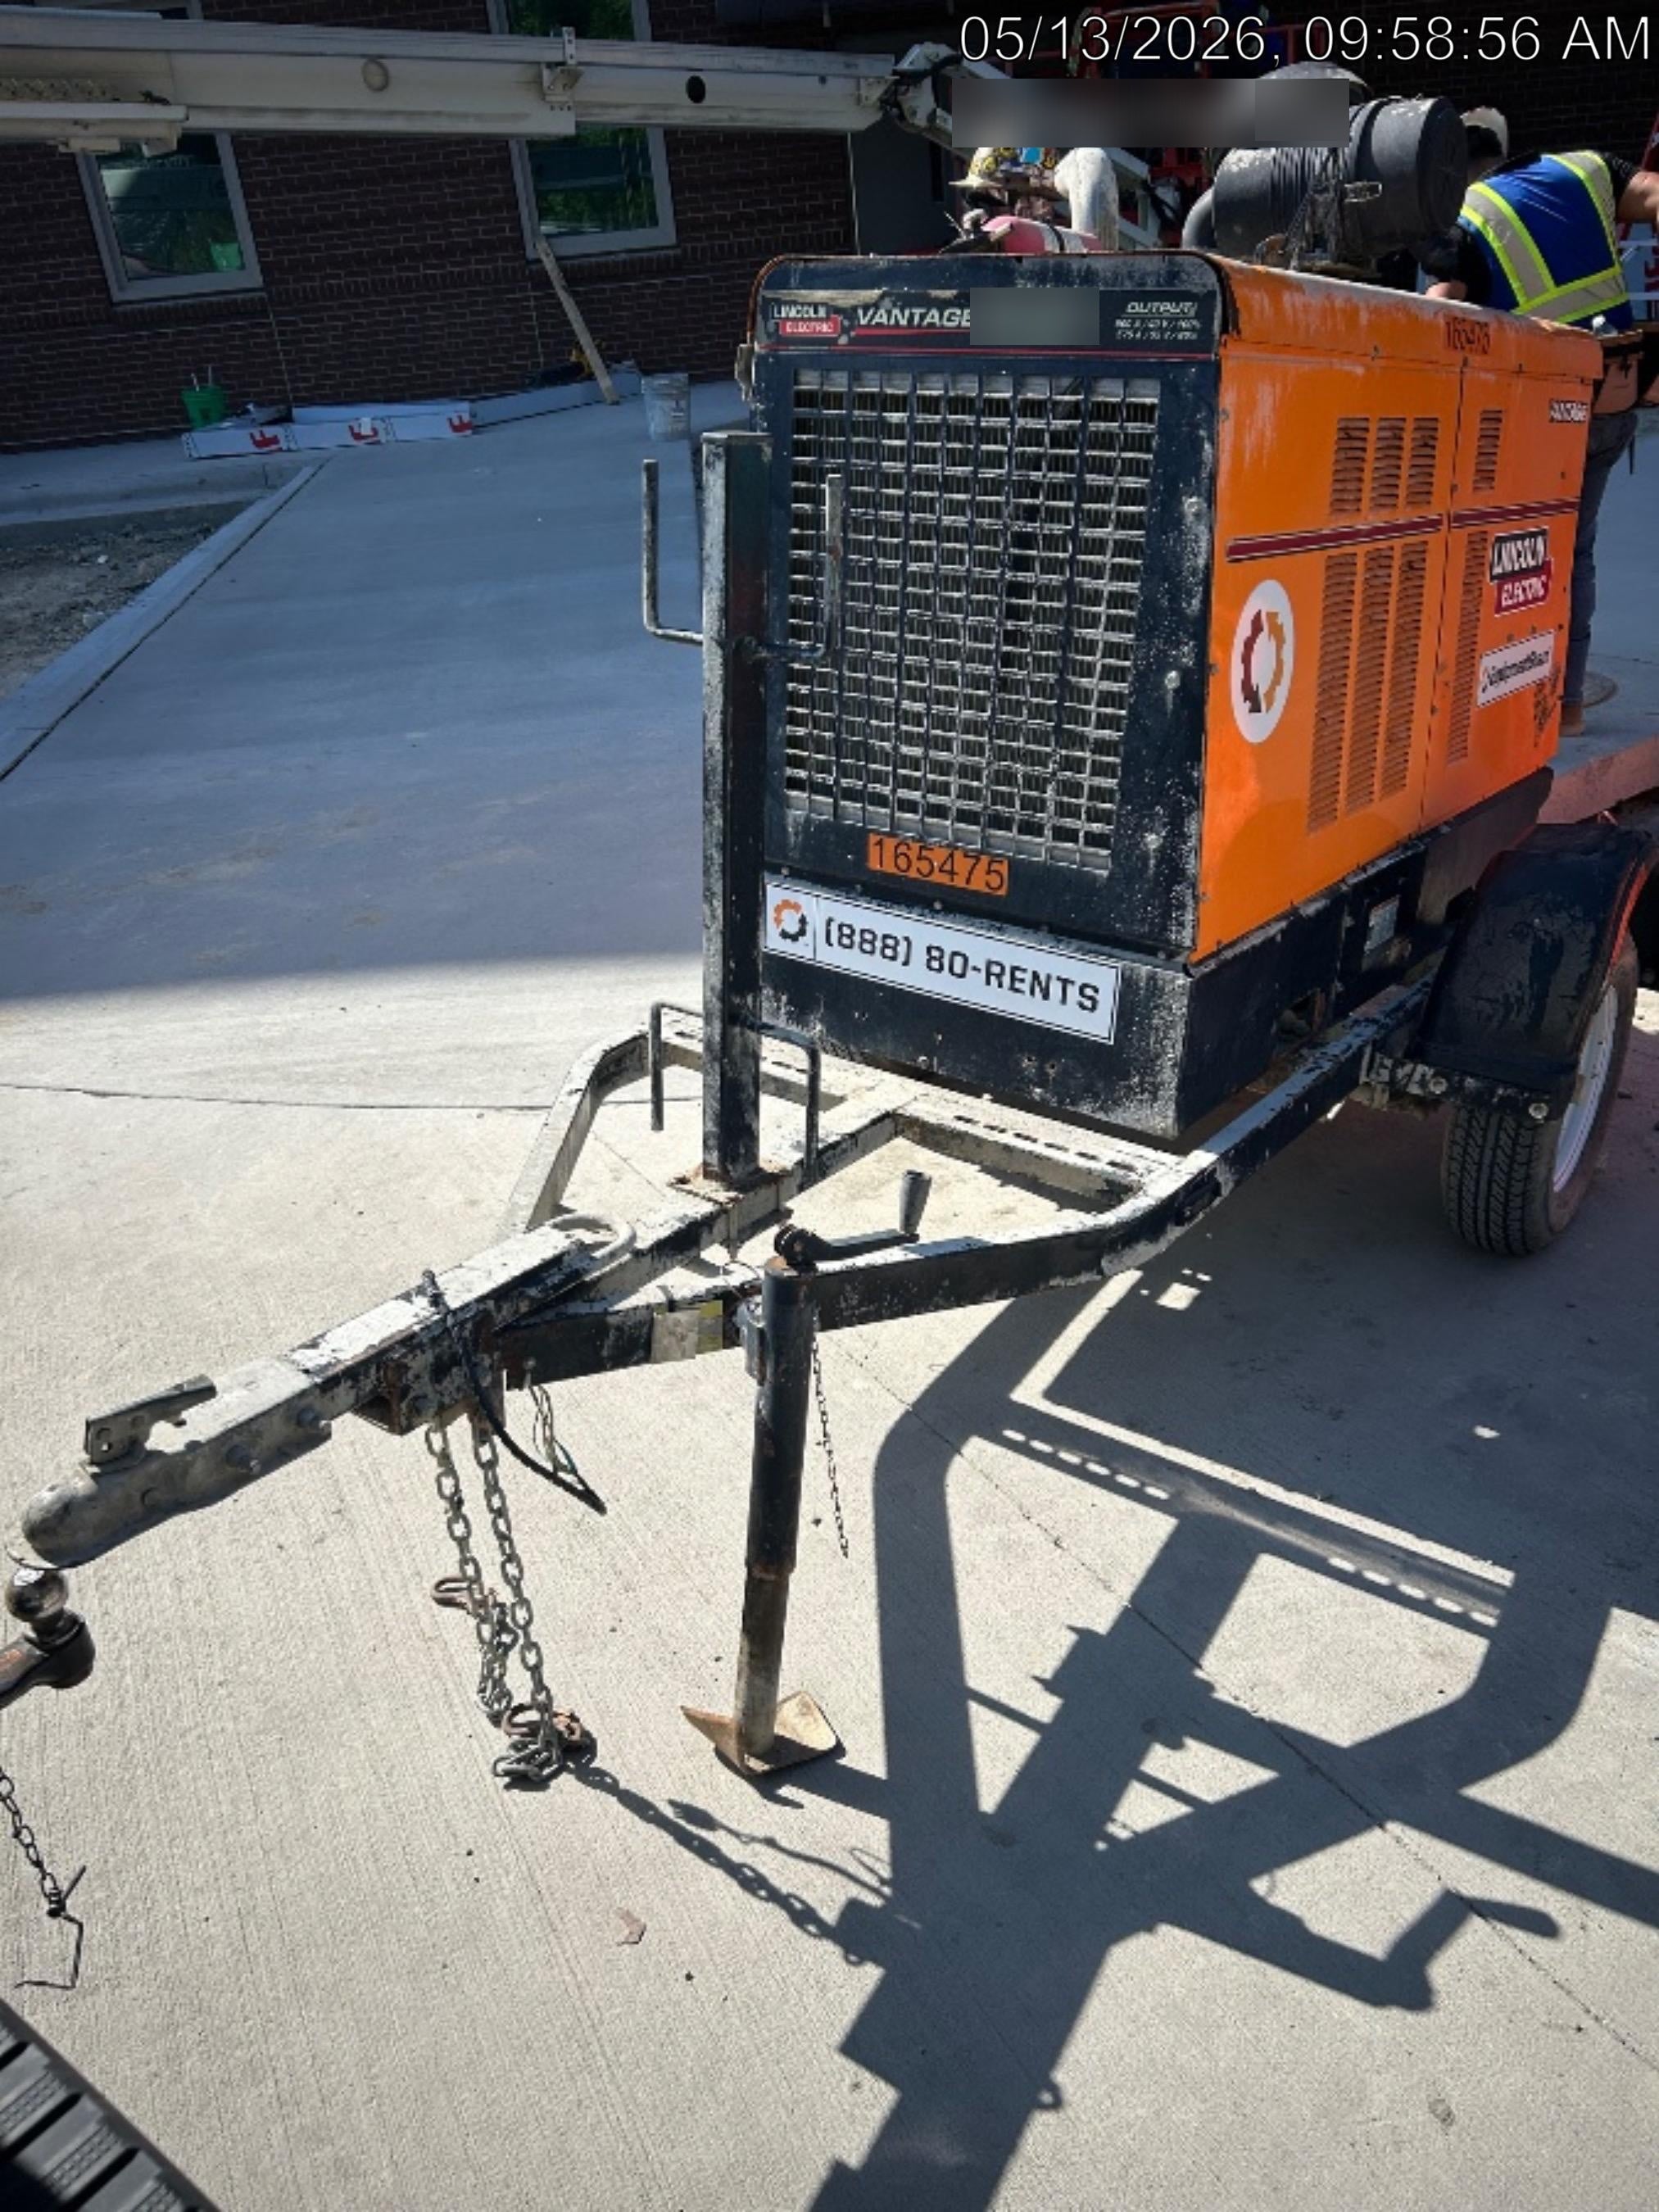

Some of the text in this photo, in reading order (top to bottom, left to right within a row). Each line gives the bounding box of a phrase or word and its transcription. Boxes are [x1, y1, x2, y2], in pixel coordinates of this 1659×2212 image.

[773, 304, 827, 319] LINCOLN
[1126, 301, 1193, 313] OUTPUT
[873, 837, 1005, 891] 165475
[824, 915, 1100, 1013] (888) 80-RENTS
